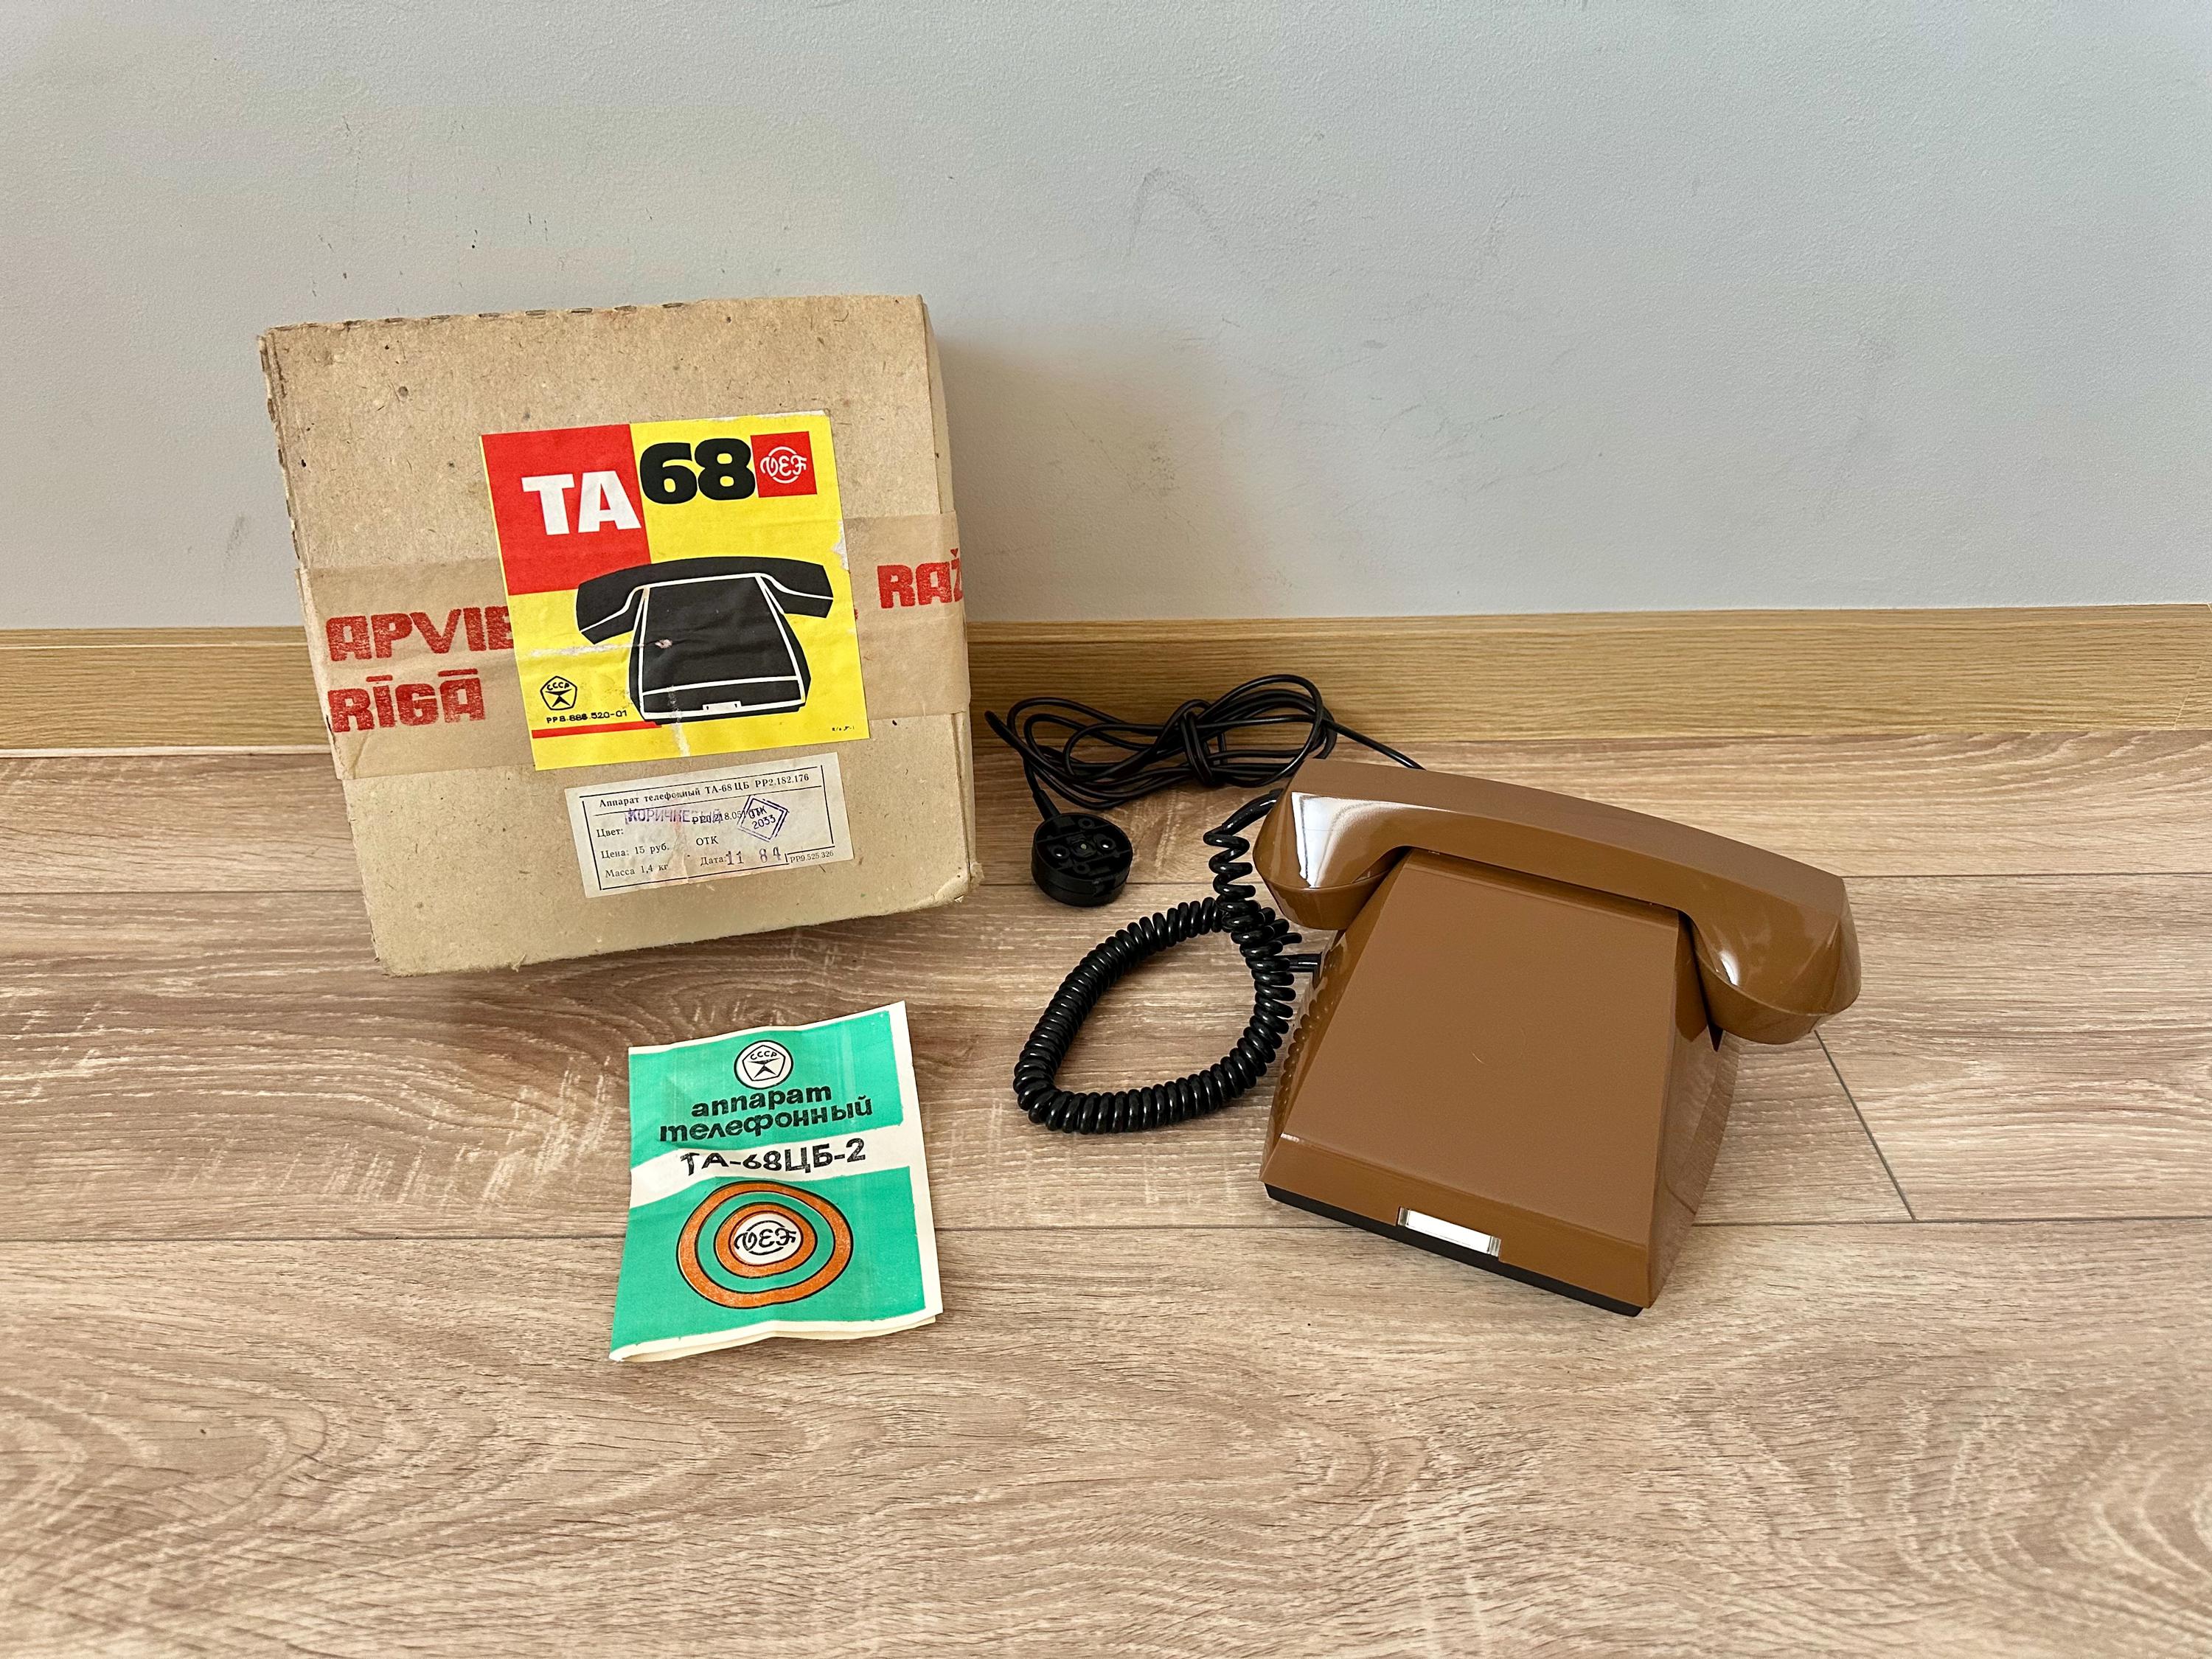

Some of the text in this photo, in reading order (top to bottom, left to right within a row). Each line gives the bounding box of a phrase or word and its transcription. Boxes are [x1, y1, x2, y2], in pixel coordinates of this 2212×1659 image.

[760, 453, 807, 478] VEF
[521, 438, 757, 535] ТА 68
[547, 681, 570, 691] СССР
[327, 668, 485, 733] RĪGĀ
[599, 797, 639, 808] Аппарат
[644, 788, 700, 802] телефонный
[705, 783, 733, 795] ТА-68
[734, 781, 750, 791] ЦБ
[748, 806, 768, 819] ОТК
[751, 814, 776, 830] 2033
[597, 828, 624, 838] Цвет:
[696, 836, 719, 846] ОТК
[601, 843, 669, 859] Цена: 15 руб.
[700, 855, 727, 866] Дата:
[726, 850, 744, 865] 11
[605, 863, 669, 878] Масса 1,4 кг
[750, 1050, 777, 1061] СССР
[691, 1085, 832, 1118] аппарат
[659, 1096, 873, 1142] телефонный
[680, 1138, 866, 1177] ТА-68ЦБ-2
[734, 1226, 797, 1252] VEF
